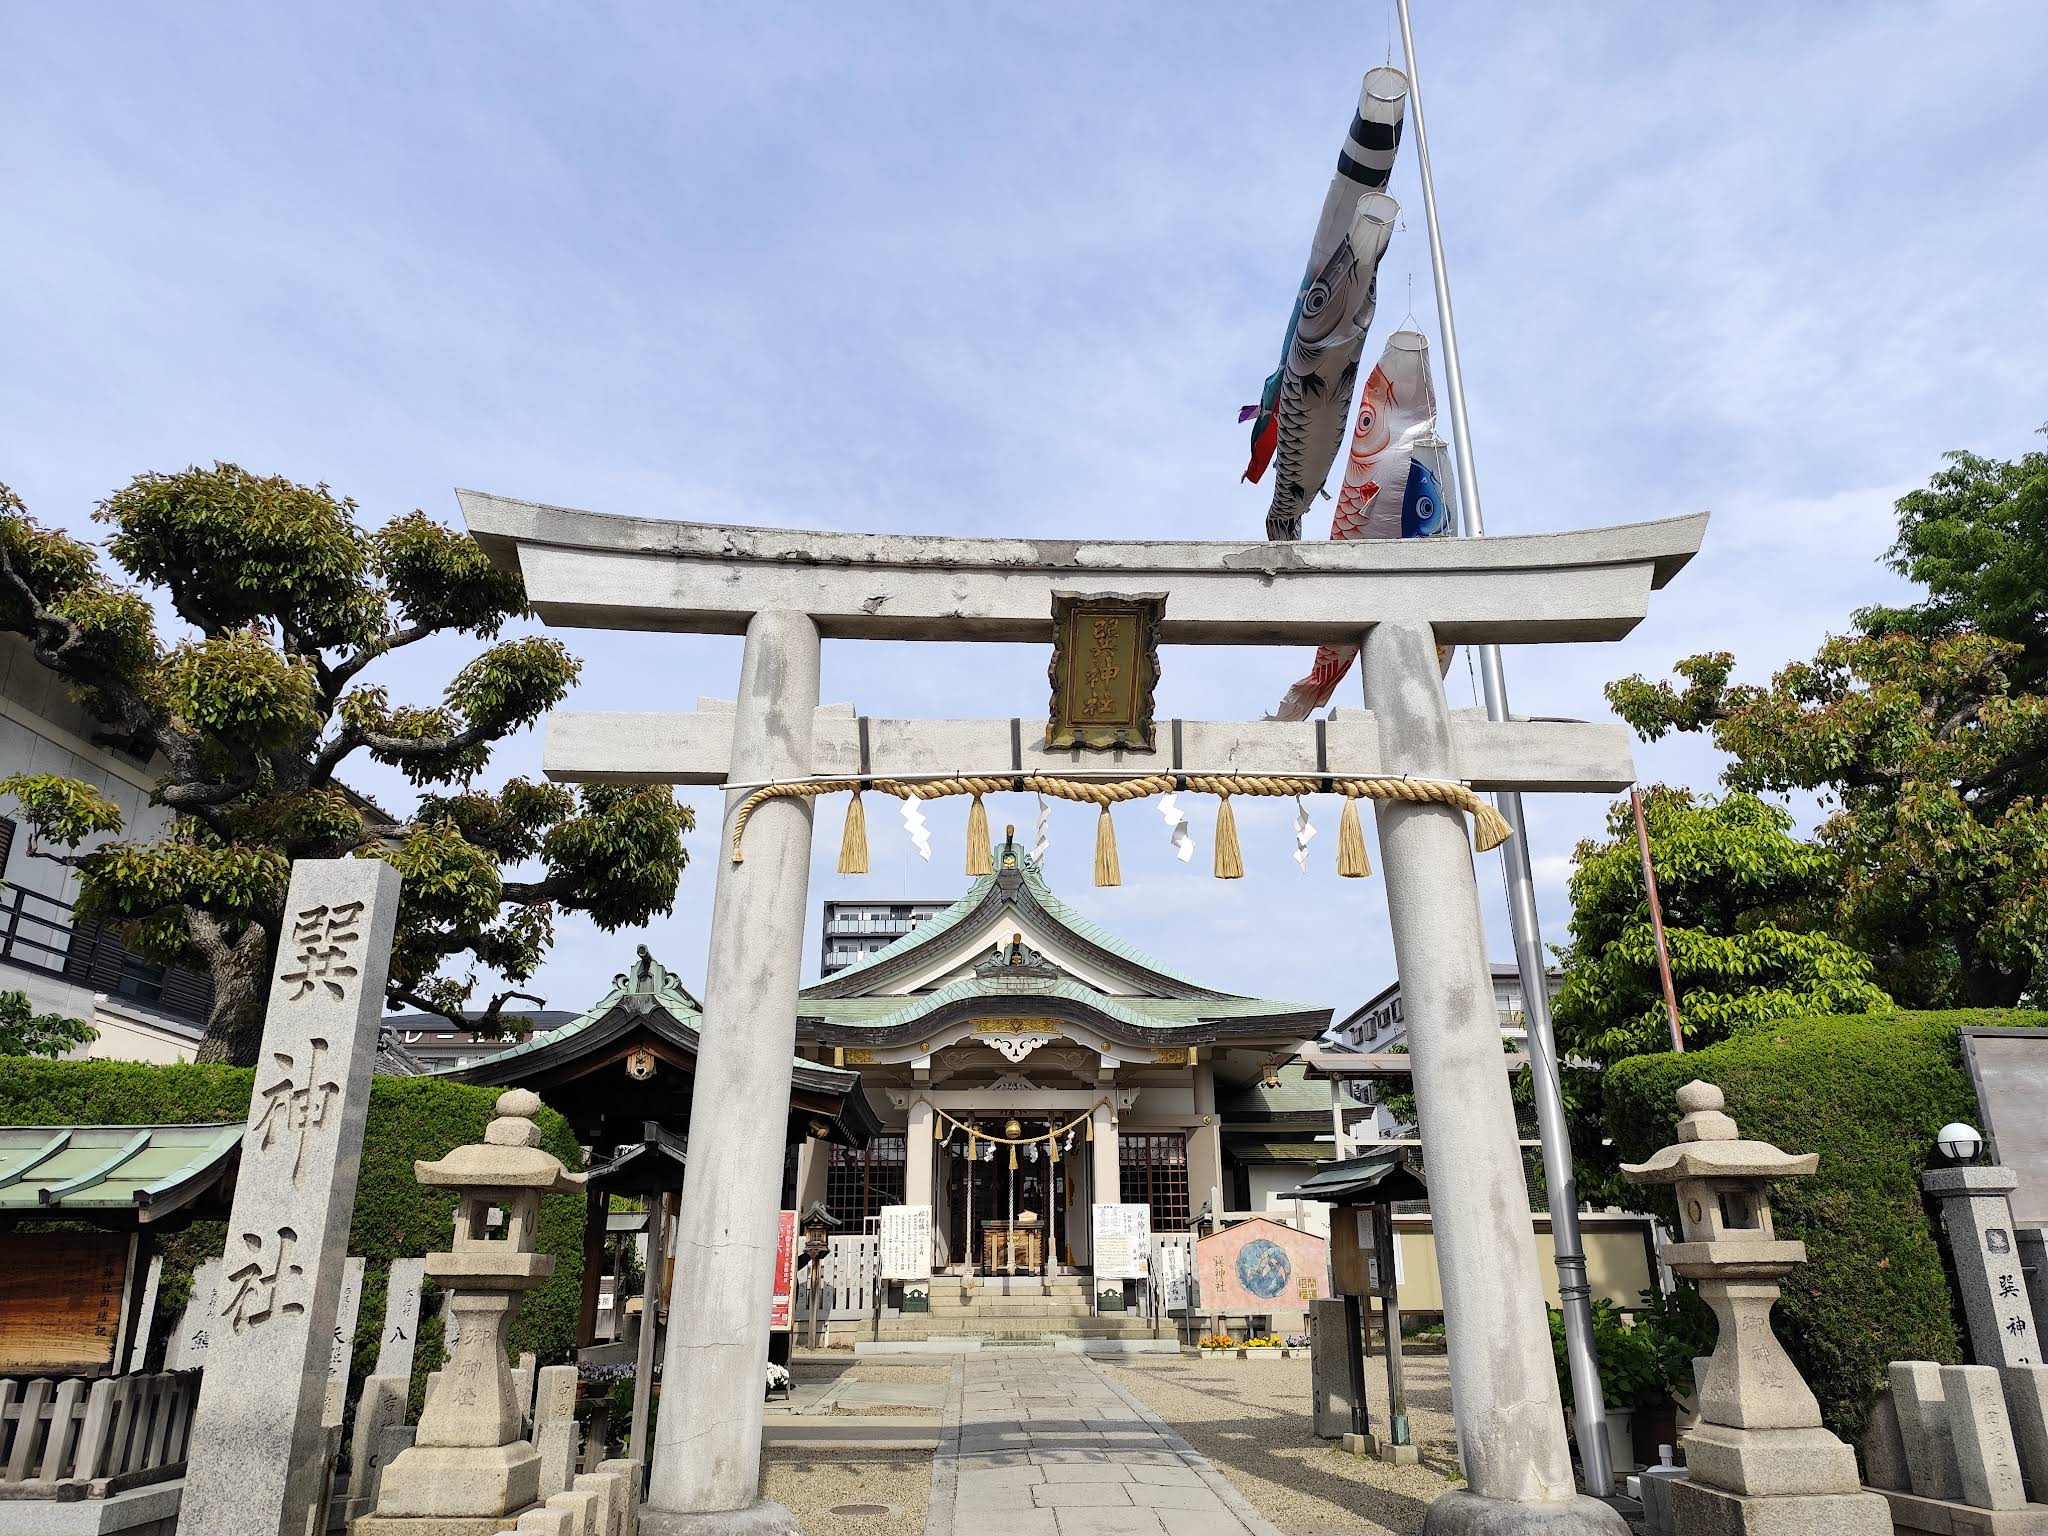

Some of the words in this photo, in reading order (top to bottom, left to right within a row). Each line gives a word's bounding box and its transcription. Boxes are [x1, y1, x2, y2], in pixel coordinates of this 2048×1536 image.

[1082, 617, 1120, 716] 巽神社
[221, 900, 365, 1337] 巽神社
[1213, 1255, 1226, 1293] 巽神社
[1998, 1274, 2029, 1364] 巽神
